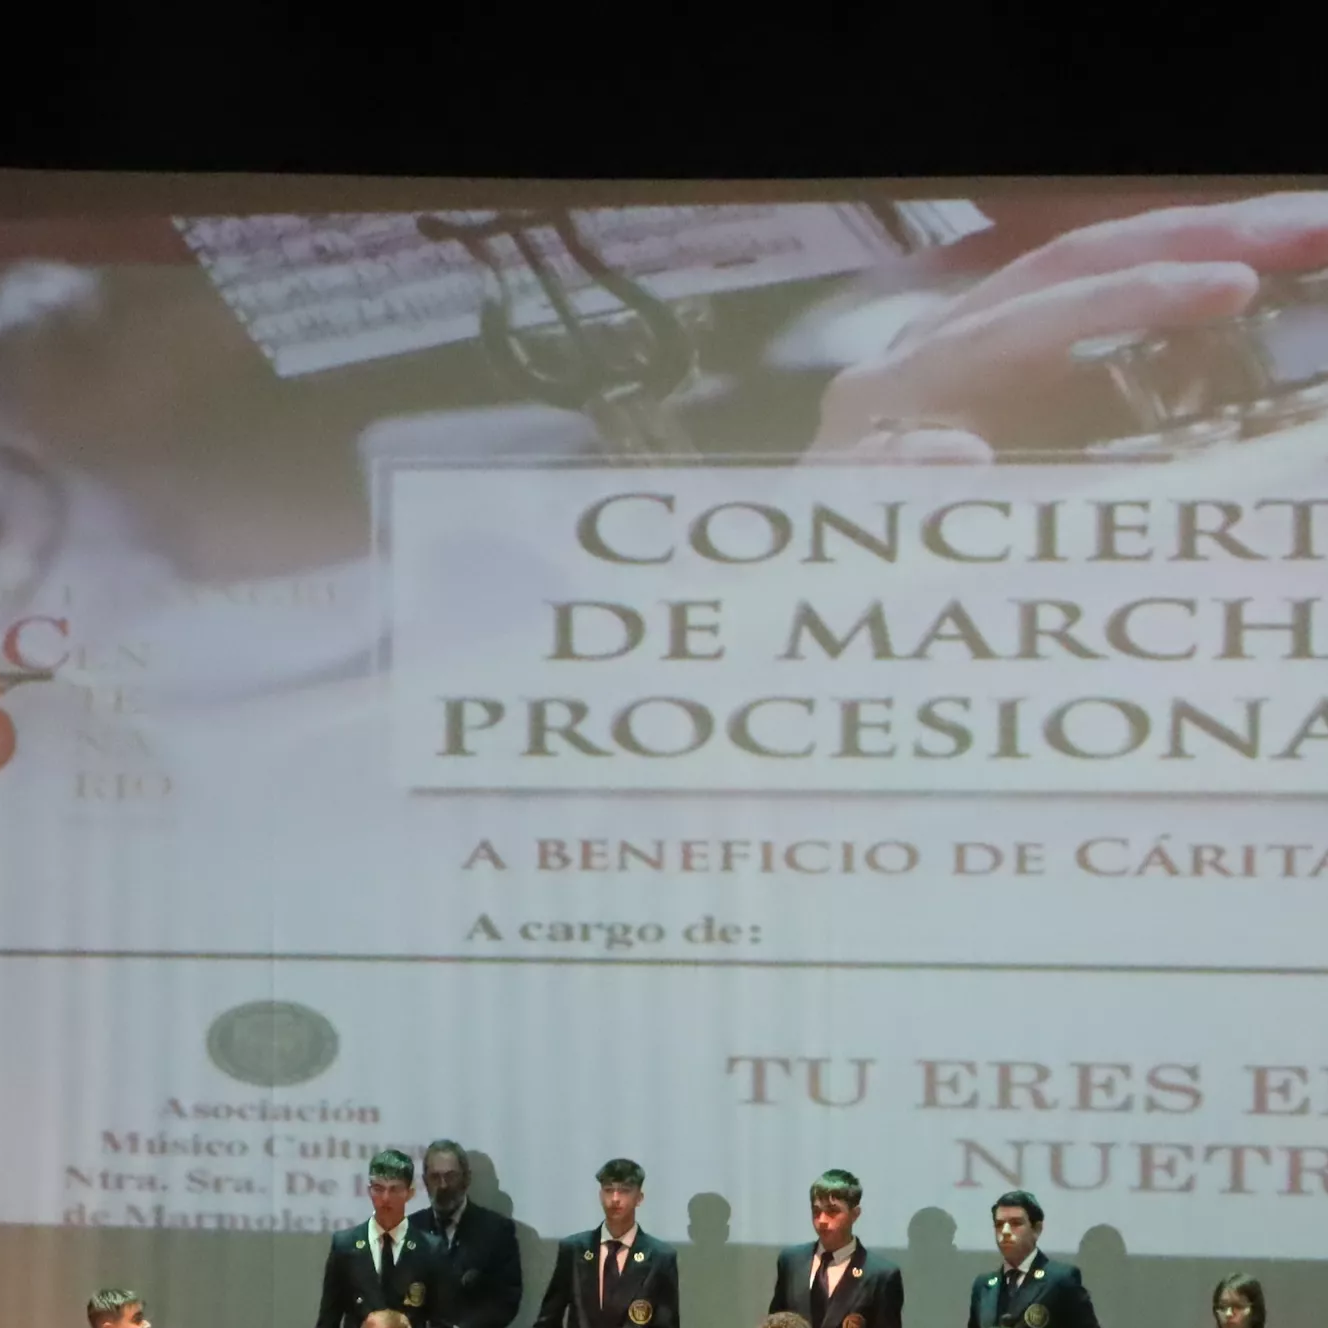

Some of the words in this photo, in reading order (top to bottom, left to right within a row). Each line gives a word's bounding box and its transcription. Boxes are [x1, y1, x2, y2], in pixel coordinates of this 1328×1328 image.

[541, 597, 727, 662] DE
[461, 837, 507, 872] A
[534, 837, 921, 875] BENEFICIO
[951, 841, 1047, 877] DE
[465, 912, 505, 943] A
[517, 917, 667, 951] cargo
[682, 915, 763, 945] de:
[726, 1054, 876, 1108] TU
[913, 1058, 1205, 1115] ERES
[160, 1097, 382, 1125] Asociación
[64, 1165, 170, 1194] Ntra.
[185, 1168, 268, 1196] Sra.
[284, 1170, 340, 1197] De
